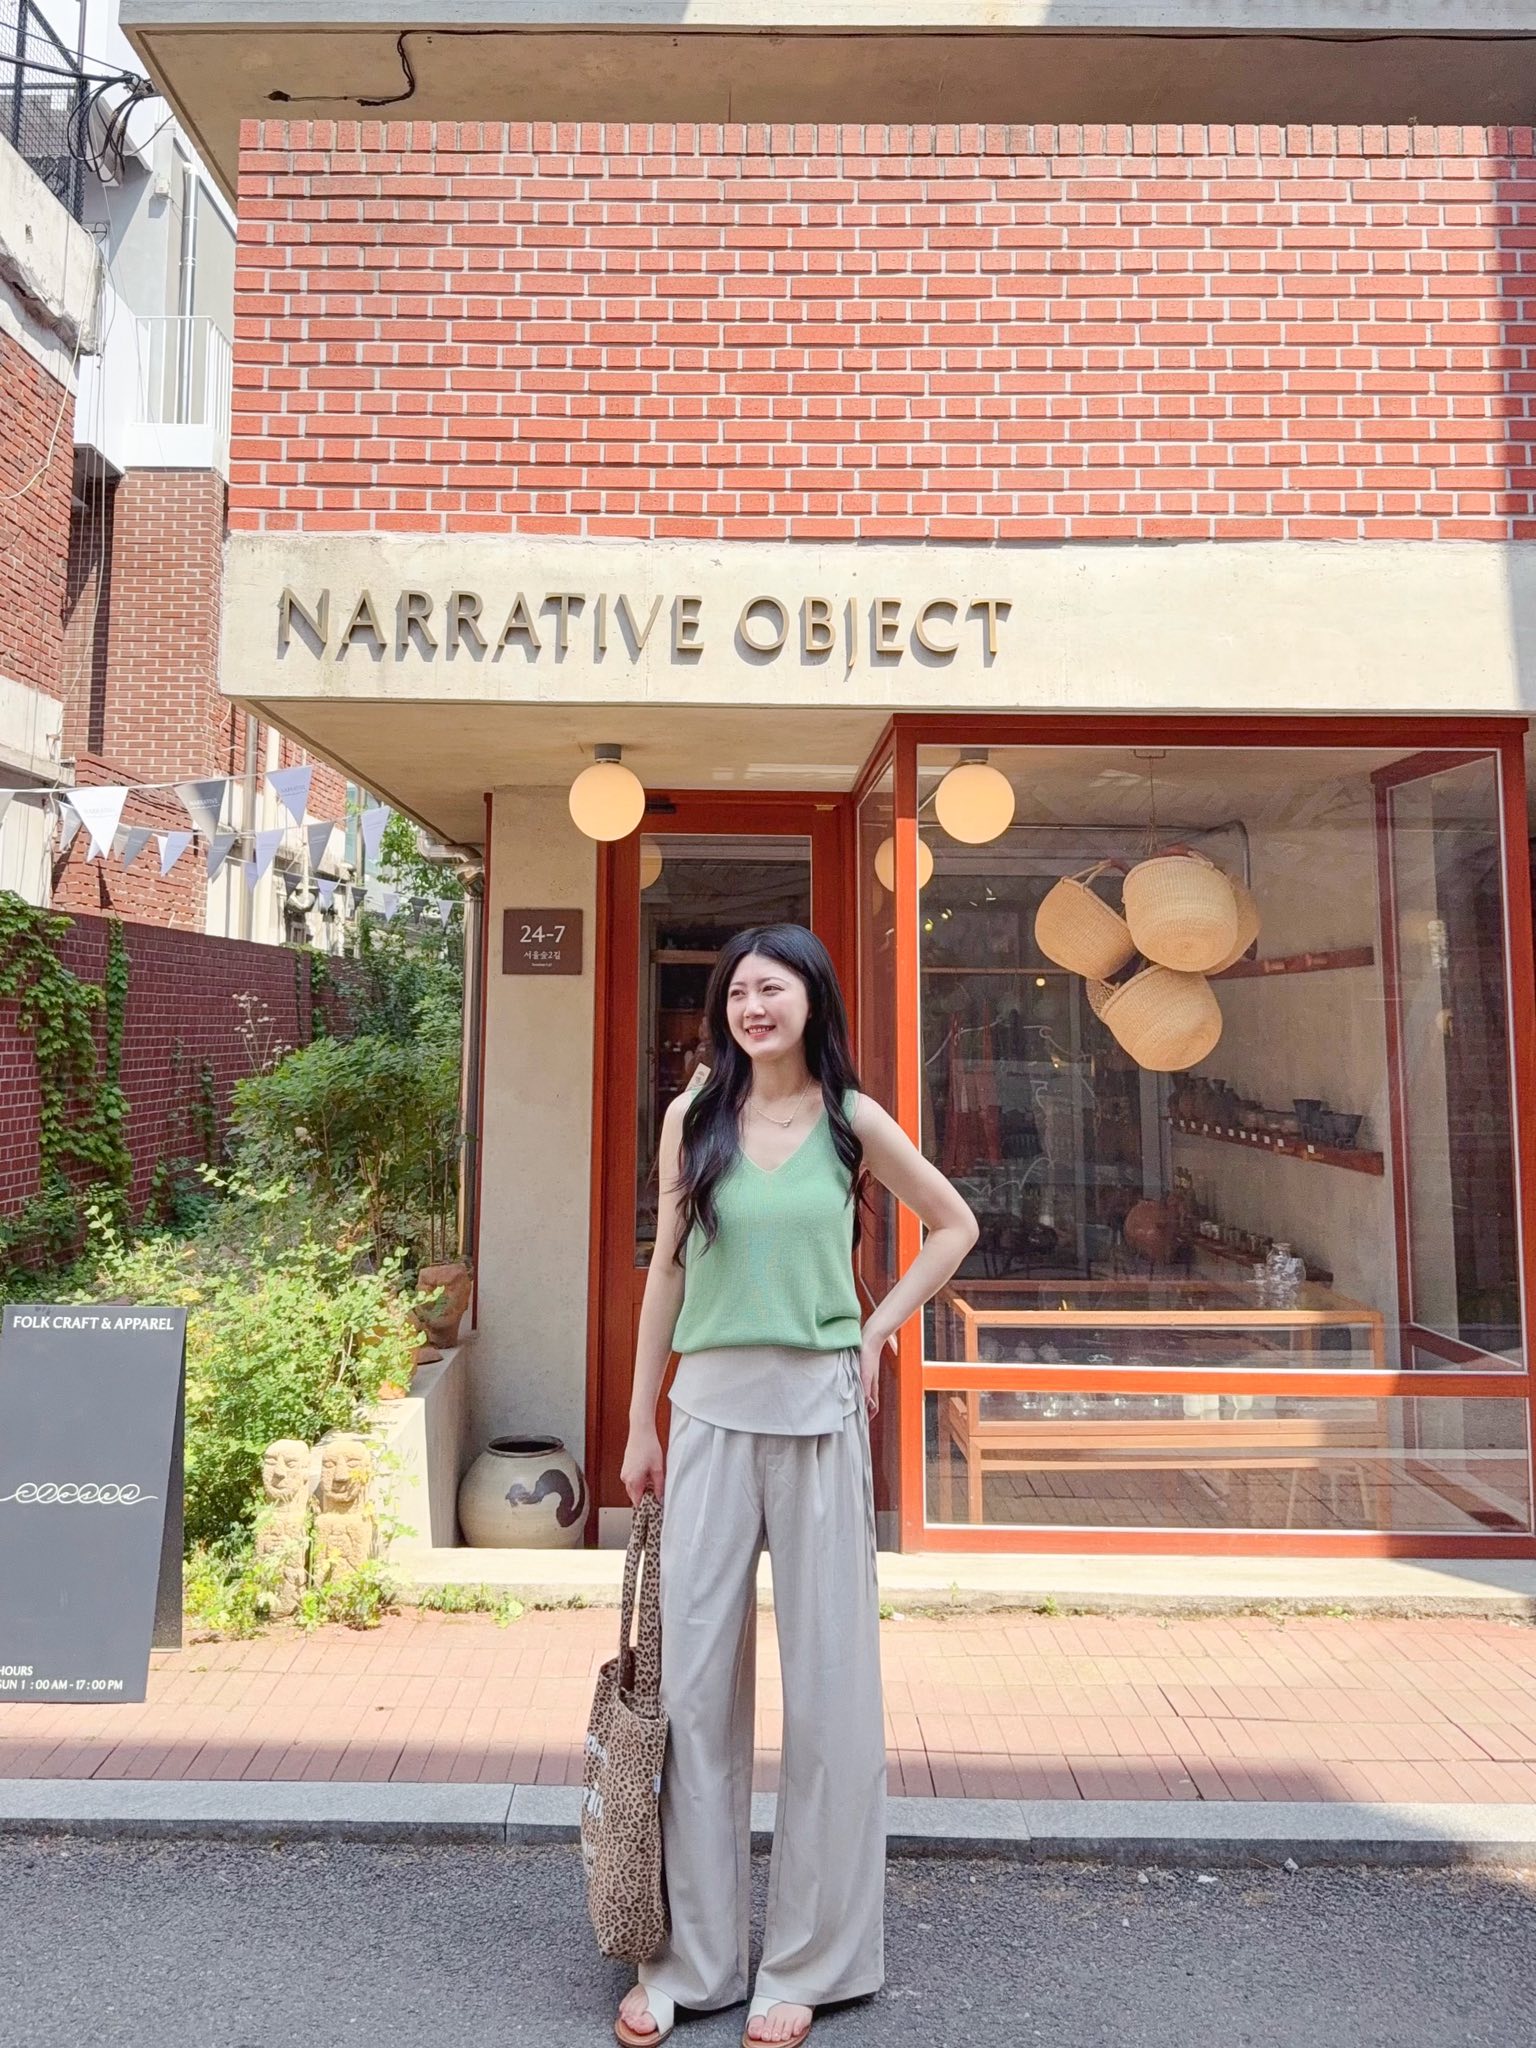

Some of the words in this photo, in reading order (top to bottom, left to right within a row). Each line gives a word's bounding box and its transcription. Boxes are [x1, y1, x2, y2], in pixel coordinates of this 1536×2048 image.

[277, 585, 705, 663] NARRATIVE
[735, 595, 1013, 676] OBJECT
[519, 925, 566, 943] 24-7
[13, 1316, 50, 1329] FOLK
[52, 1316, 100, 1330] CRAFT
[101, 1318, 112, 1330] &
[113, 1317, 175, 1331] APPAREL
[51, 1679, 68, 1690] AM
[107, 1679, 124, 1690] PM
